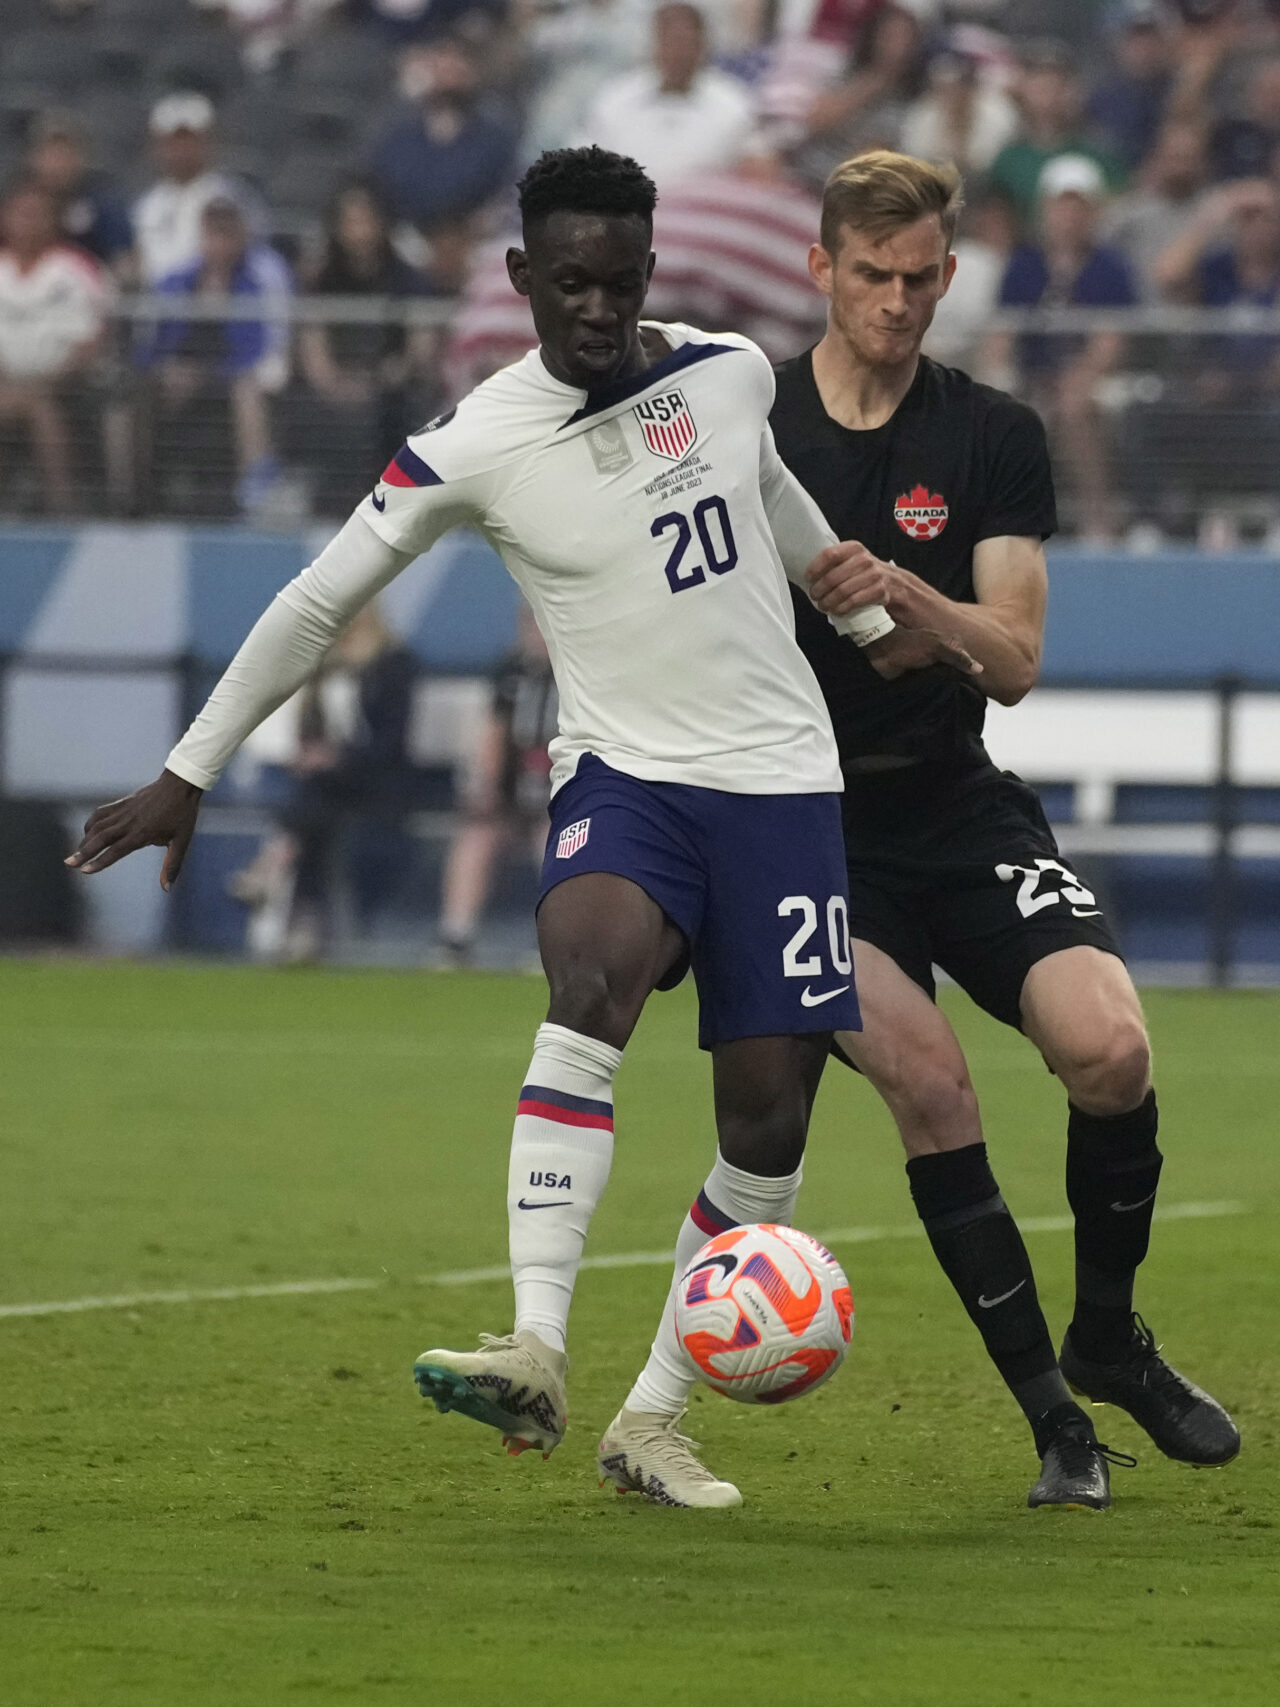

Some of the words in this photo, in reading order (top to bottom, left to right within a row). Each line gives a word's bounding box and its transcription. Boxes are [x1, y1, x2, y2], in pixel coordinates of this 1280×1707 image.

[637, 393, 684, 421] USA
[644, 478, 672, 496] NATIONS
[671, 468, 695, 485] LEAGUE
[695, 462, 713, 475] FINAL
[670, 483, 686, 497] JUNE
[687, 477, 702, 490] 2023
[895, 508, 947, 518] CANADA
[650, 494, 738, 594] 20
[561, 820, 588, 841] USA
[994, 858, 1096, 919] 23
[777, 895, 852, 977] 20
[529, 1171, 571, 1190] USA
